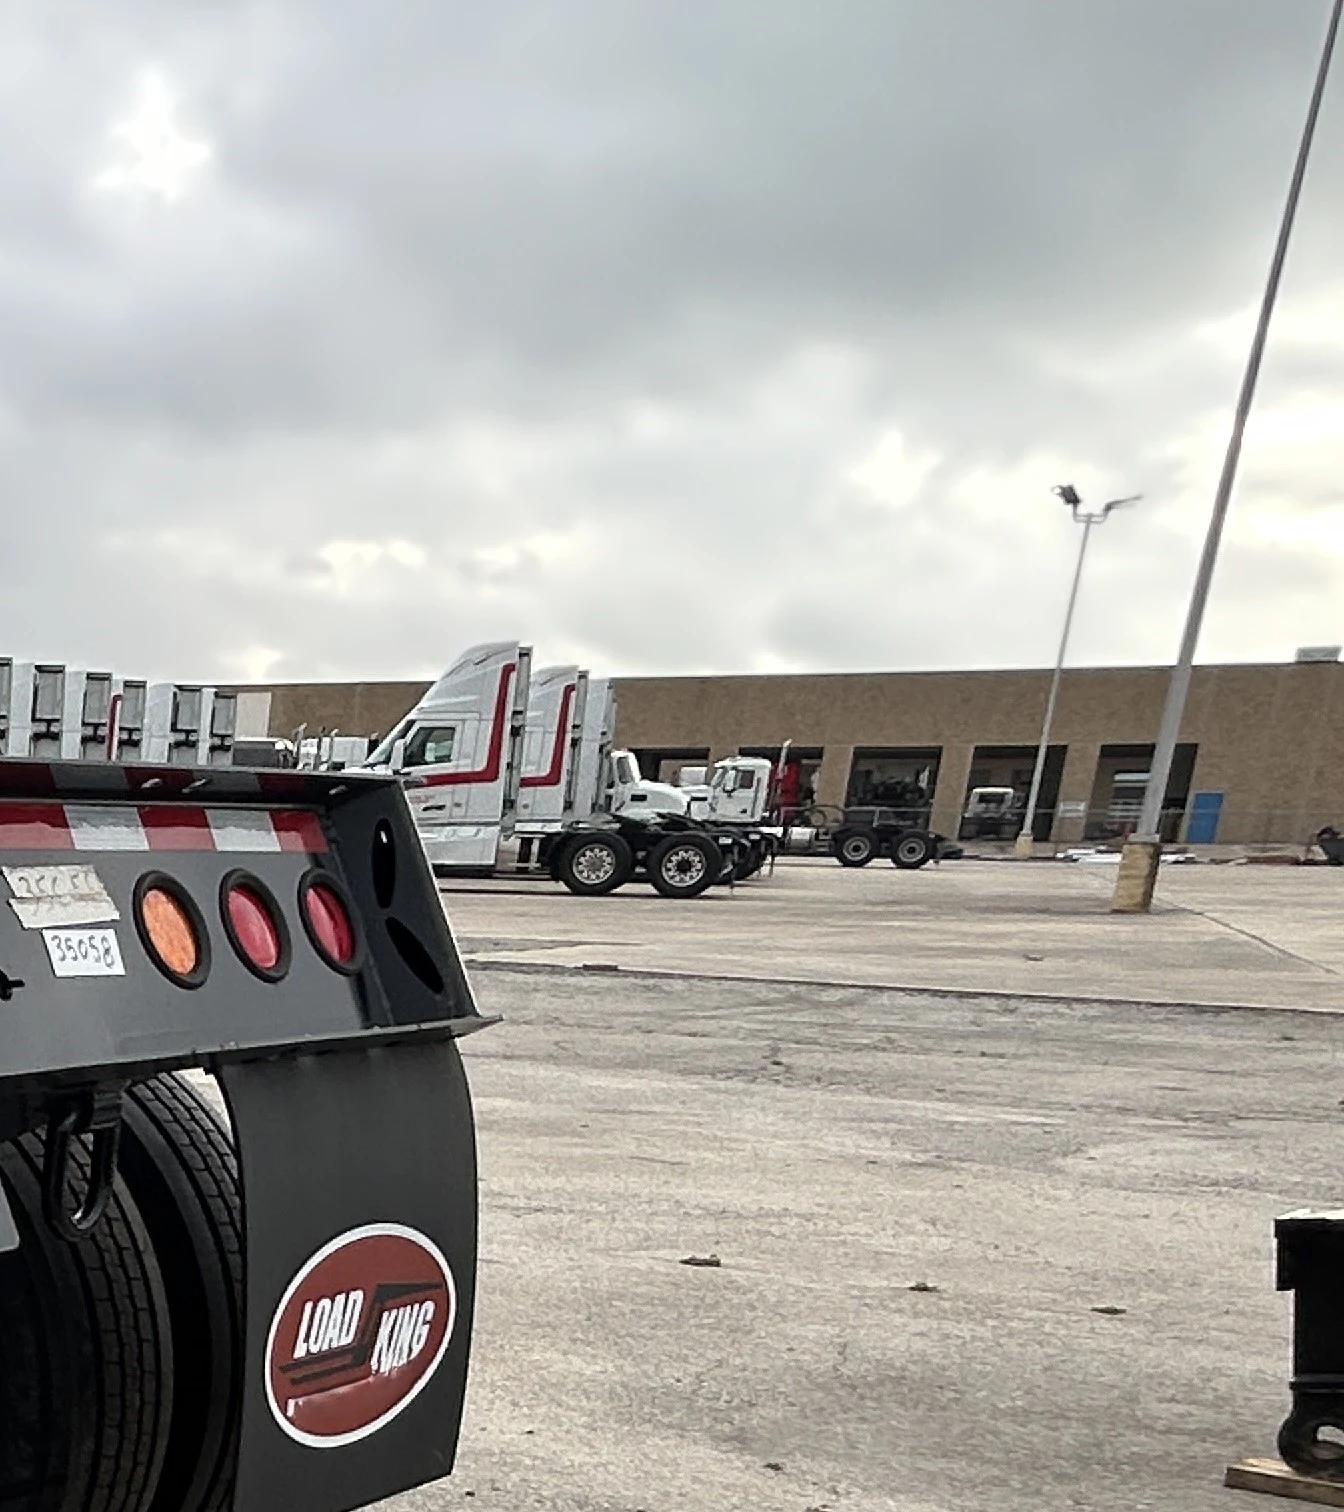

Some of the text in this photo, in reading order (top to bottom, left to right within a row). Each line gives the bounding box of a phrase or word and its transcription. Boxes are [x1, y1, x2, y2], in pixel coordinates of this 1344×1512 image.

[50, 934, 116, 970] 35058
[293, 1289, 436, 1375] LOAD KING
